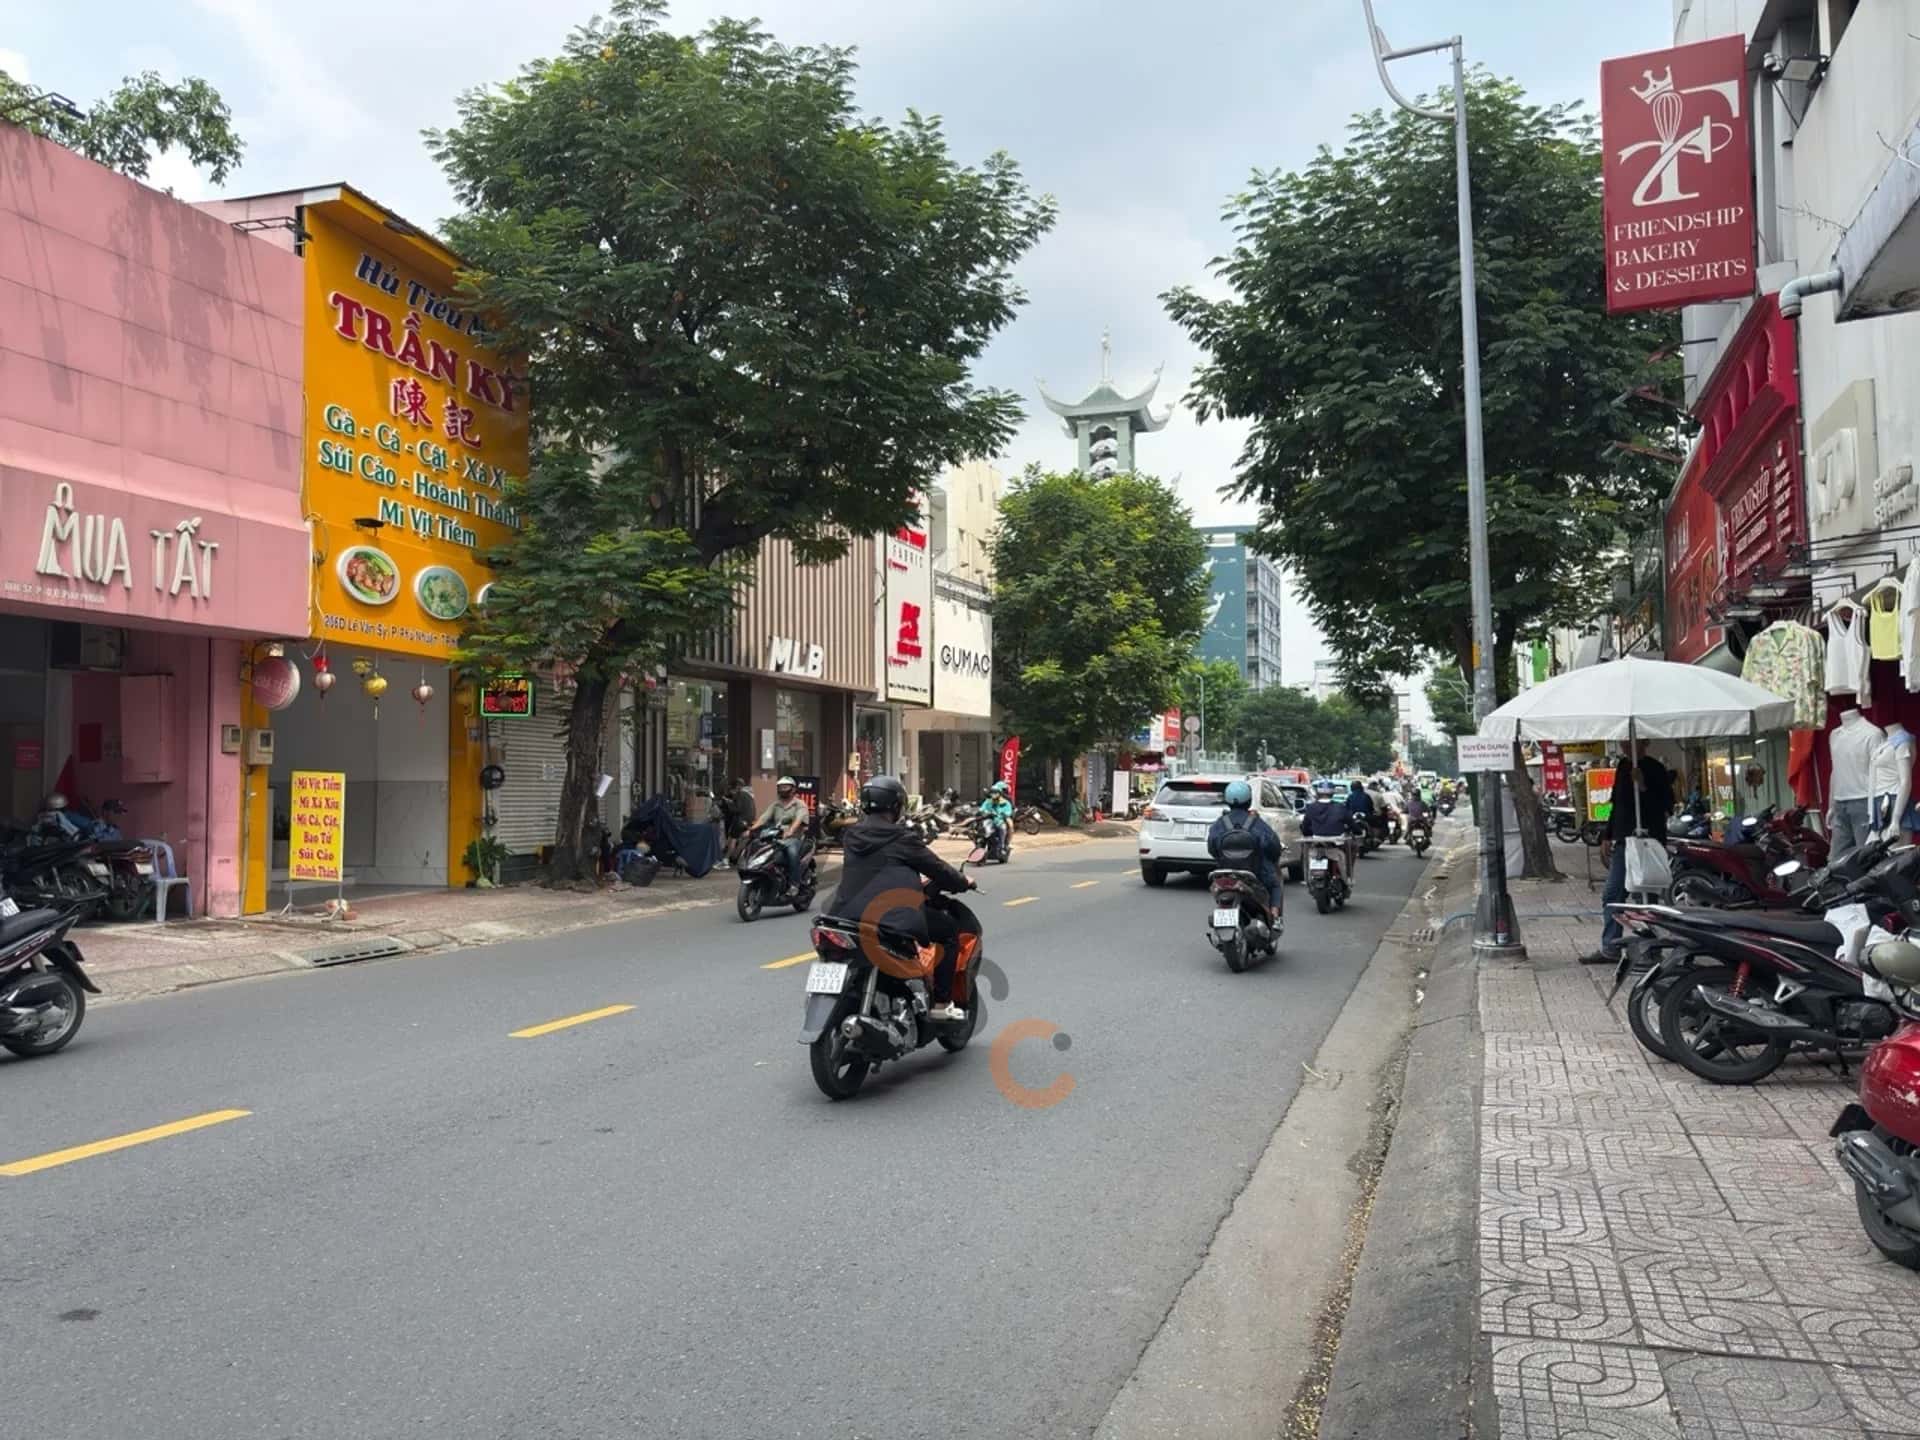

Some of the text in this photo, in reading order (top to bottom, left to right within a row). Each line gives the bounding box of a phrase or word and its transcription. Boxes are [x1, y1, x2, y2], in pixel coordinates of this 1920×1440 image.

[1614, 206, 1744, 241] FRIENDSHIP
[1615, 239, 1700, 267] BAKERY
[1614, 259, 1747, 293] & DESSERTS
[330, 292, 461, 387] TRẦN
[769, 634, 824, 678] MLB
[940, 644, 991, 675] GUMAC
